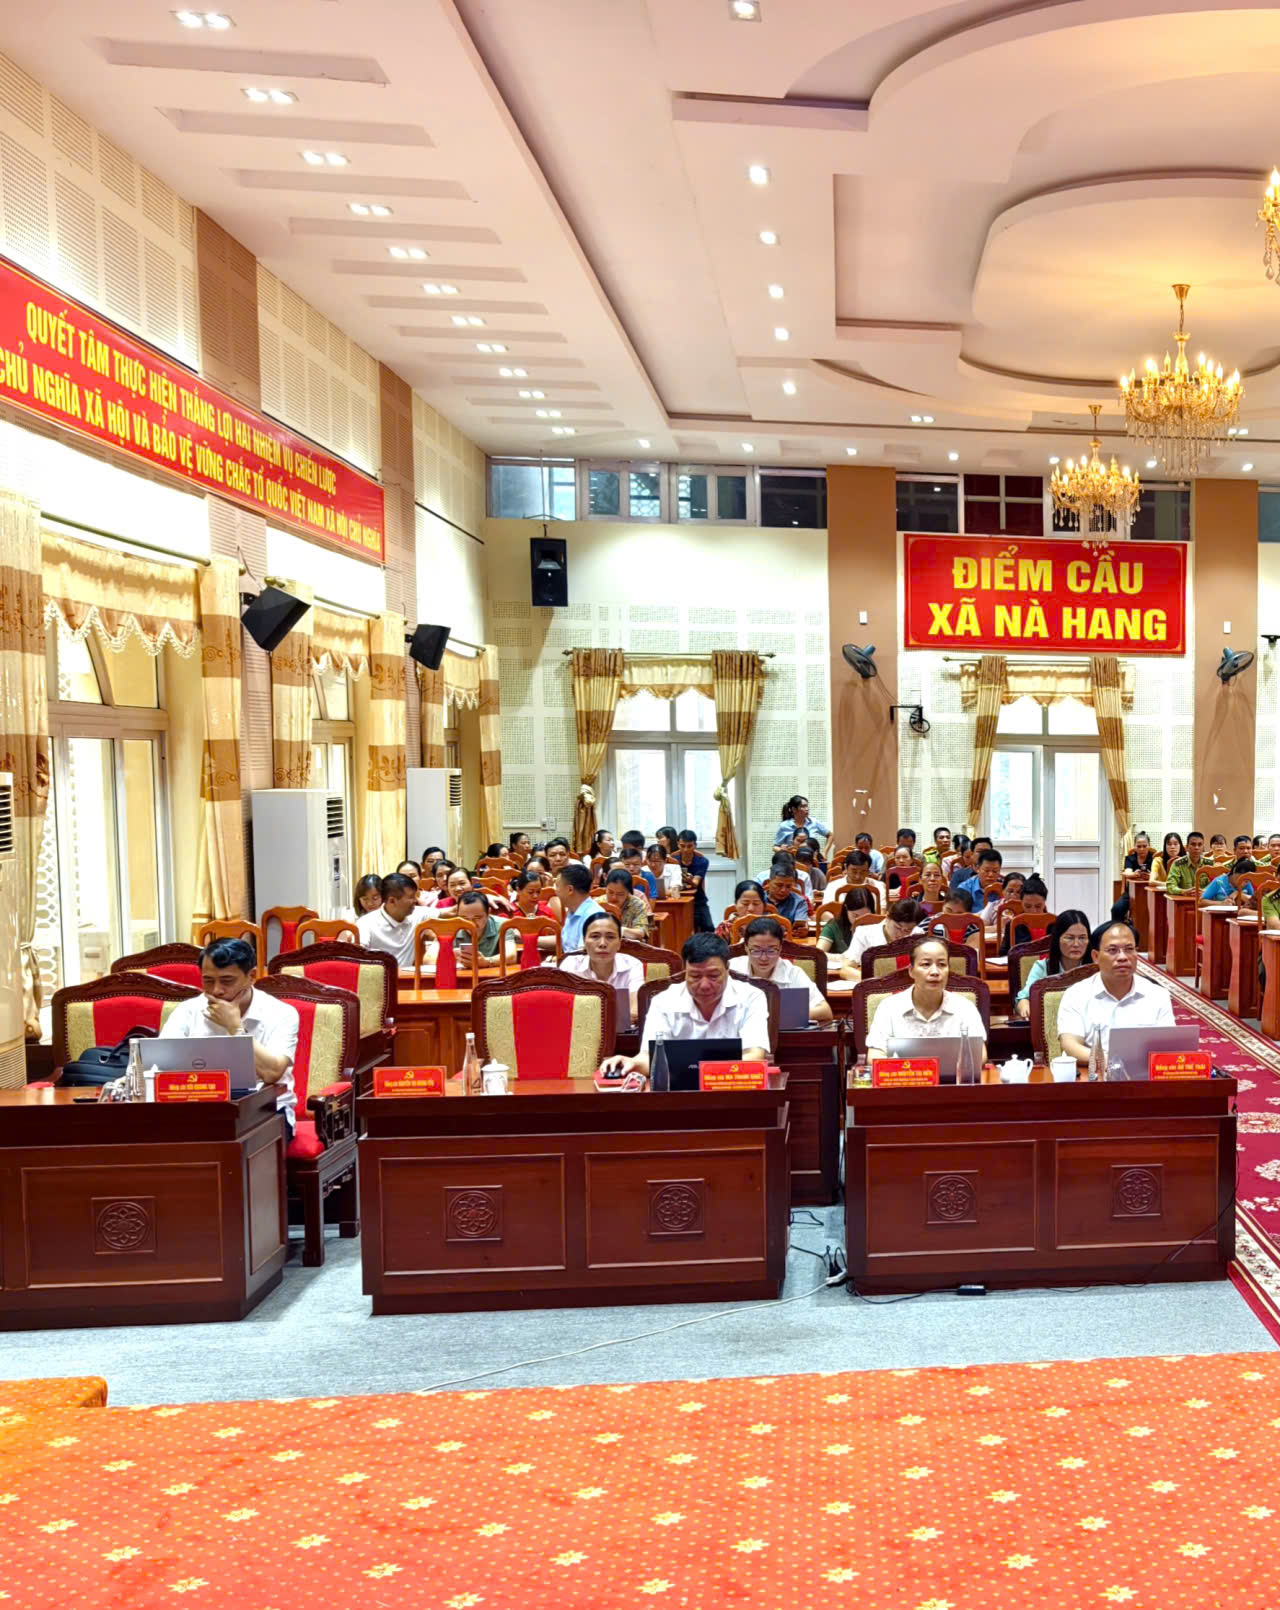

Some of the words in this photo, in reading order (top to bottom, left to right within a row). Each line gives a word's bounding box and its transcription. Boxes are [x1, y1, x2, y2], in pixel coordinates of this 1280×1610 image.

[26, 301, 75, 359] QUYẾT
[78, 328, 110, 378] TÂM
[112, 348, 146, 398] THỰC
[149, 370, 177, 414] HIỆN
[179, 386, 216, 433] THẮNG
[217, 408, 233, 446] LỢI
[235, 418, 251, 452] HAI
[253, 428, 281, 468] NHIỆM
[282, 444, 293, 478] VỤ
[32, 363, 81, 419] NGHĨA
[84, 388, 104, 428] XÃ
[107, 399, 130, 446] HỘI
[132, 411, 150, 450] VÀ
[152, 414, 177, 462] BẢO
[179, 433, 193, 475] VỆ
[195, 440, 223, 482] VỮNG
[226, 456, 251, 496] CHẮC
[253, 464, 264, 501] TỔ
[266, 475, 288, 512] QUỐC
[928, 597, 982, 637] XÃ
[995, 599, 1049, 639] NÀ
[1062, 607, 1167, 641] HANG
[952, 545, 1053, 592] ĐIỂM
[1067, 550, 1144, 595] CẦU
